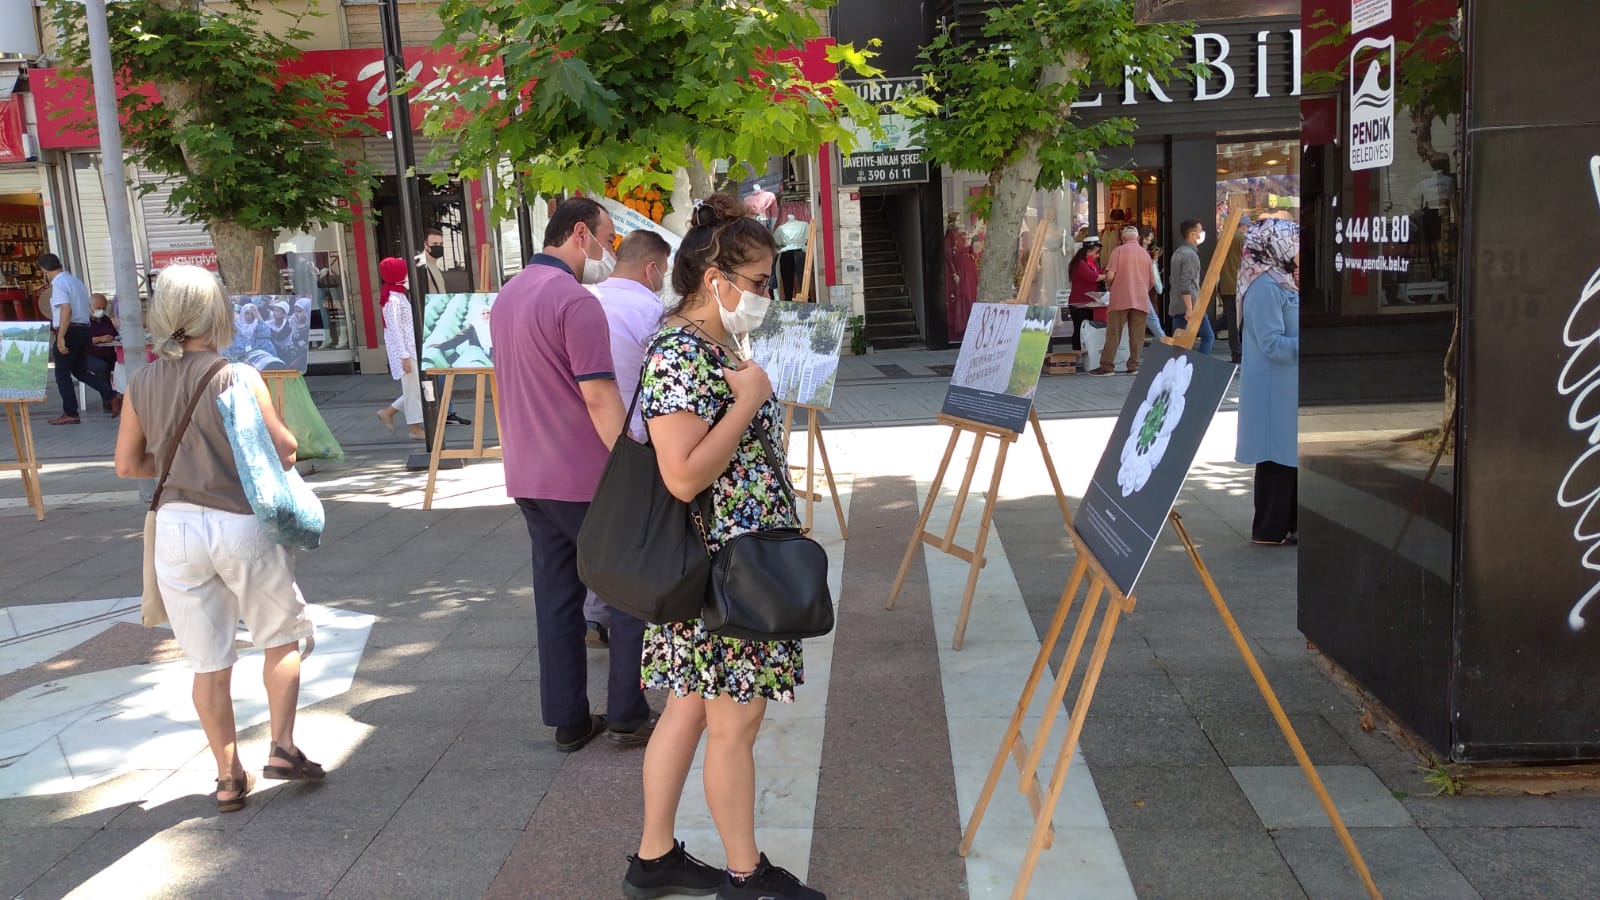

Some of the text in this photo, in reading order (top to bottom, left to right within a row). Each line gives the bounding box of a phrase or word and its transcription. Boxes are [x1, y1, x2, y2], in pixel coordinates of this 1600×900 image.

[867, 169, 886, 181] 390
[889, 168, 899, 180] 61
[902, 168, 911, 179] 11
[1345, 215, 1410, 243] 444 81 80
[1344, 255, 1409, 273] www.pendik.bel.tr
